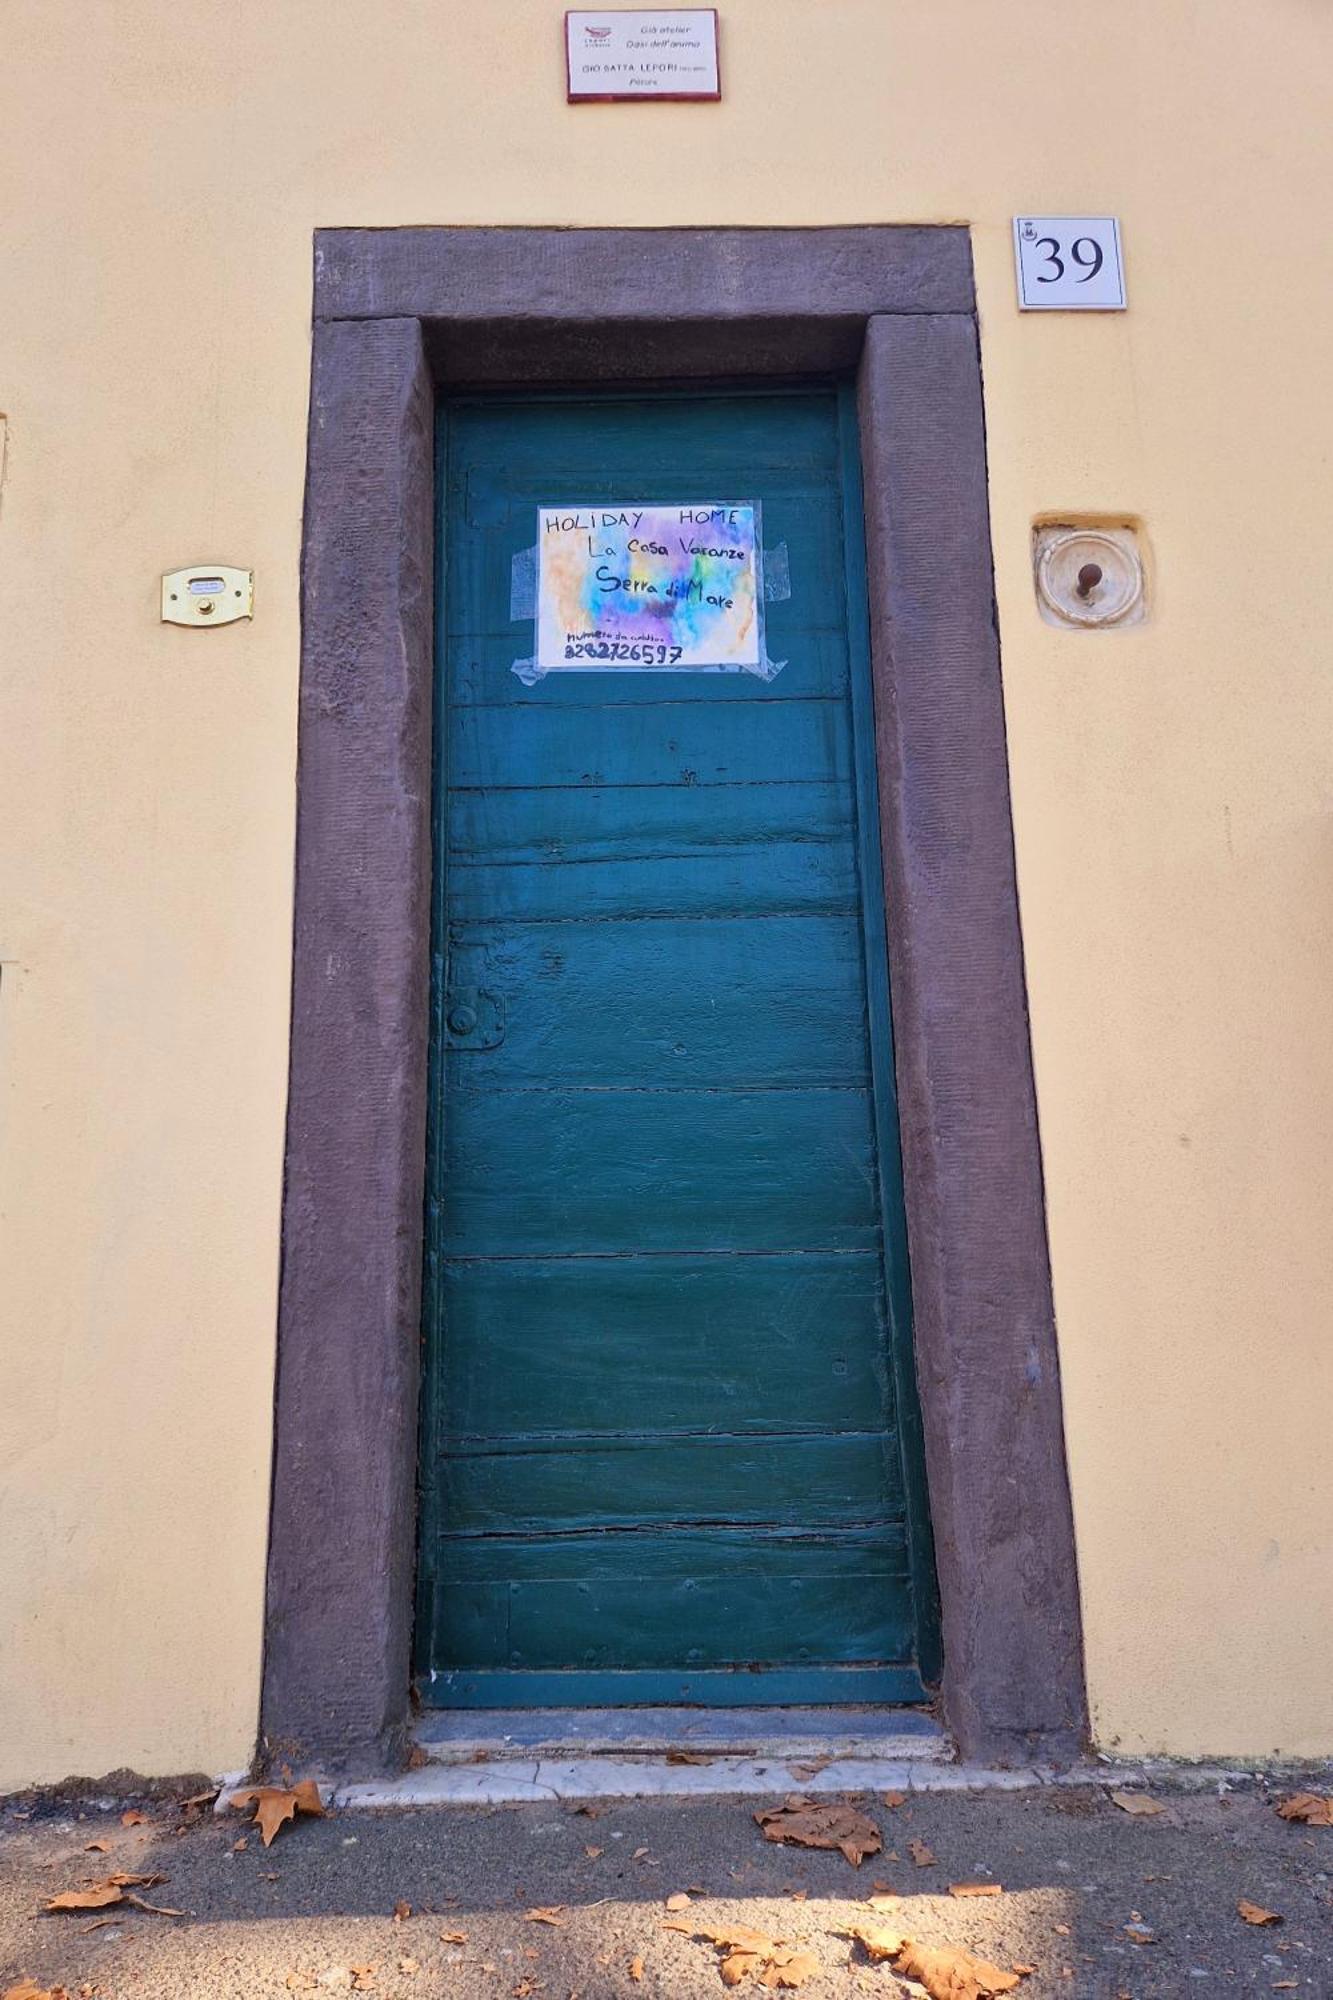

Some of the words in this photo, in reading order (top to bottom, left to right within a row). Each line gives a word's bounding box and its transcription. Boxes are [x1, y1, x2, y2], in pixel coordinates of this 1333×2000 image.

[659, 25, 691, 35] atelier
[640, 63, 678, 73] LEPORI
[1035, 237, 1104, 284] 39
[545, 511, 644, 533] HOLIDAY
[679, 509, 740, 526] HOME
[587, 535, 617, 558] La
[627, 538, 669, 556] Casa
[679, 537, 745, 561] Vacanze
[595, 565, 658, 593] Serra
[665, 581, 679, 598] di
[685, 579, 734, 609] Mare
